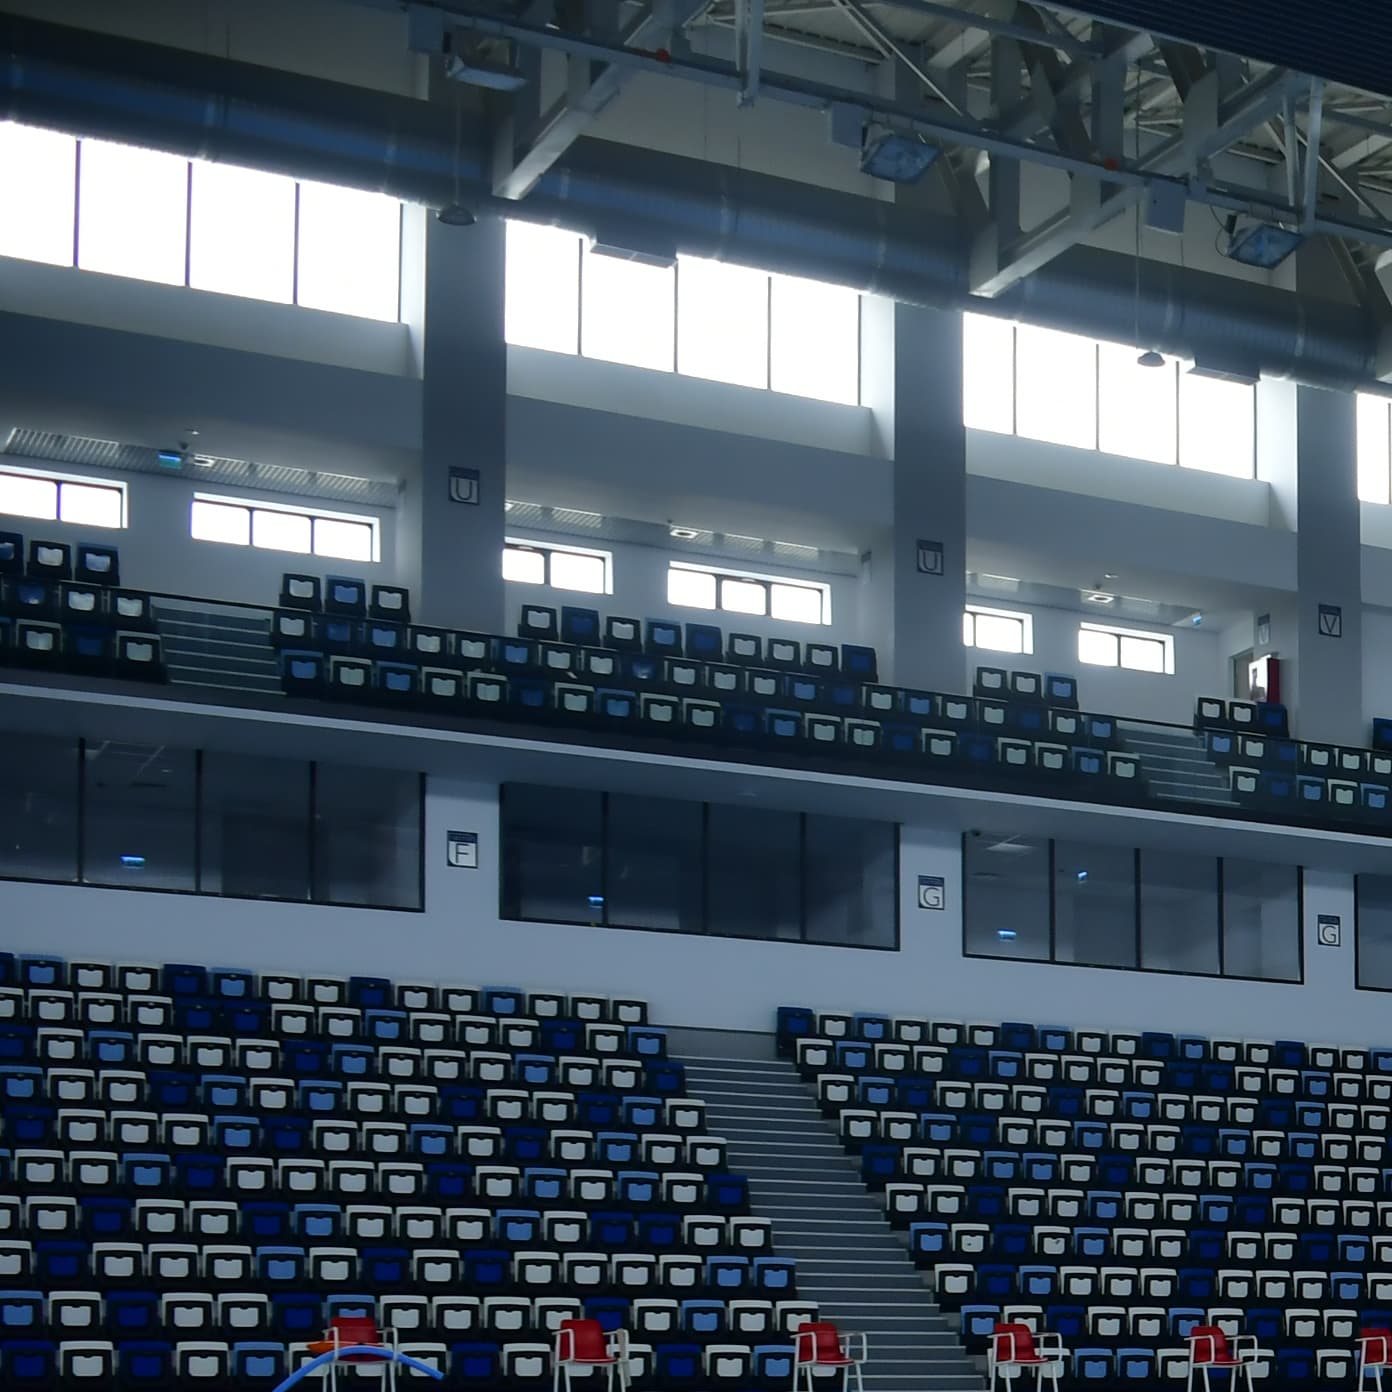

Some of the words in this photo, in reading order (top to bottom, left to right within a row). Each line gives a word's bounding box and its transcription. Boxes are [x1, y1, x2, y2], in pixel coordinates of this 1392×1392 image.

[455, 477, 473, 501] U
[922, 550, 938, 571] U
[1323, 614, 1337, 634] V
[455, 842, 470, 864] F
[923, 886, 940, 907] G
[1322, 925, 1337, 944] G
